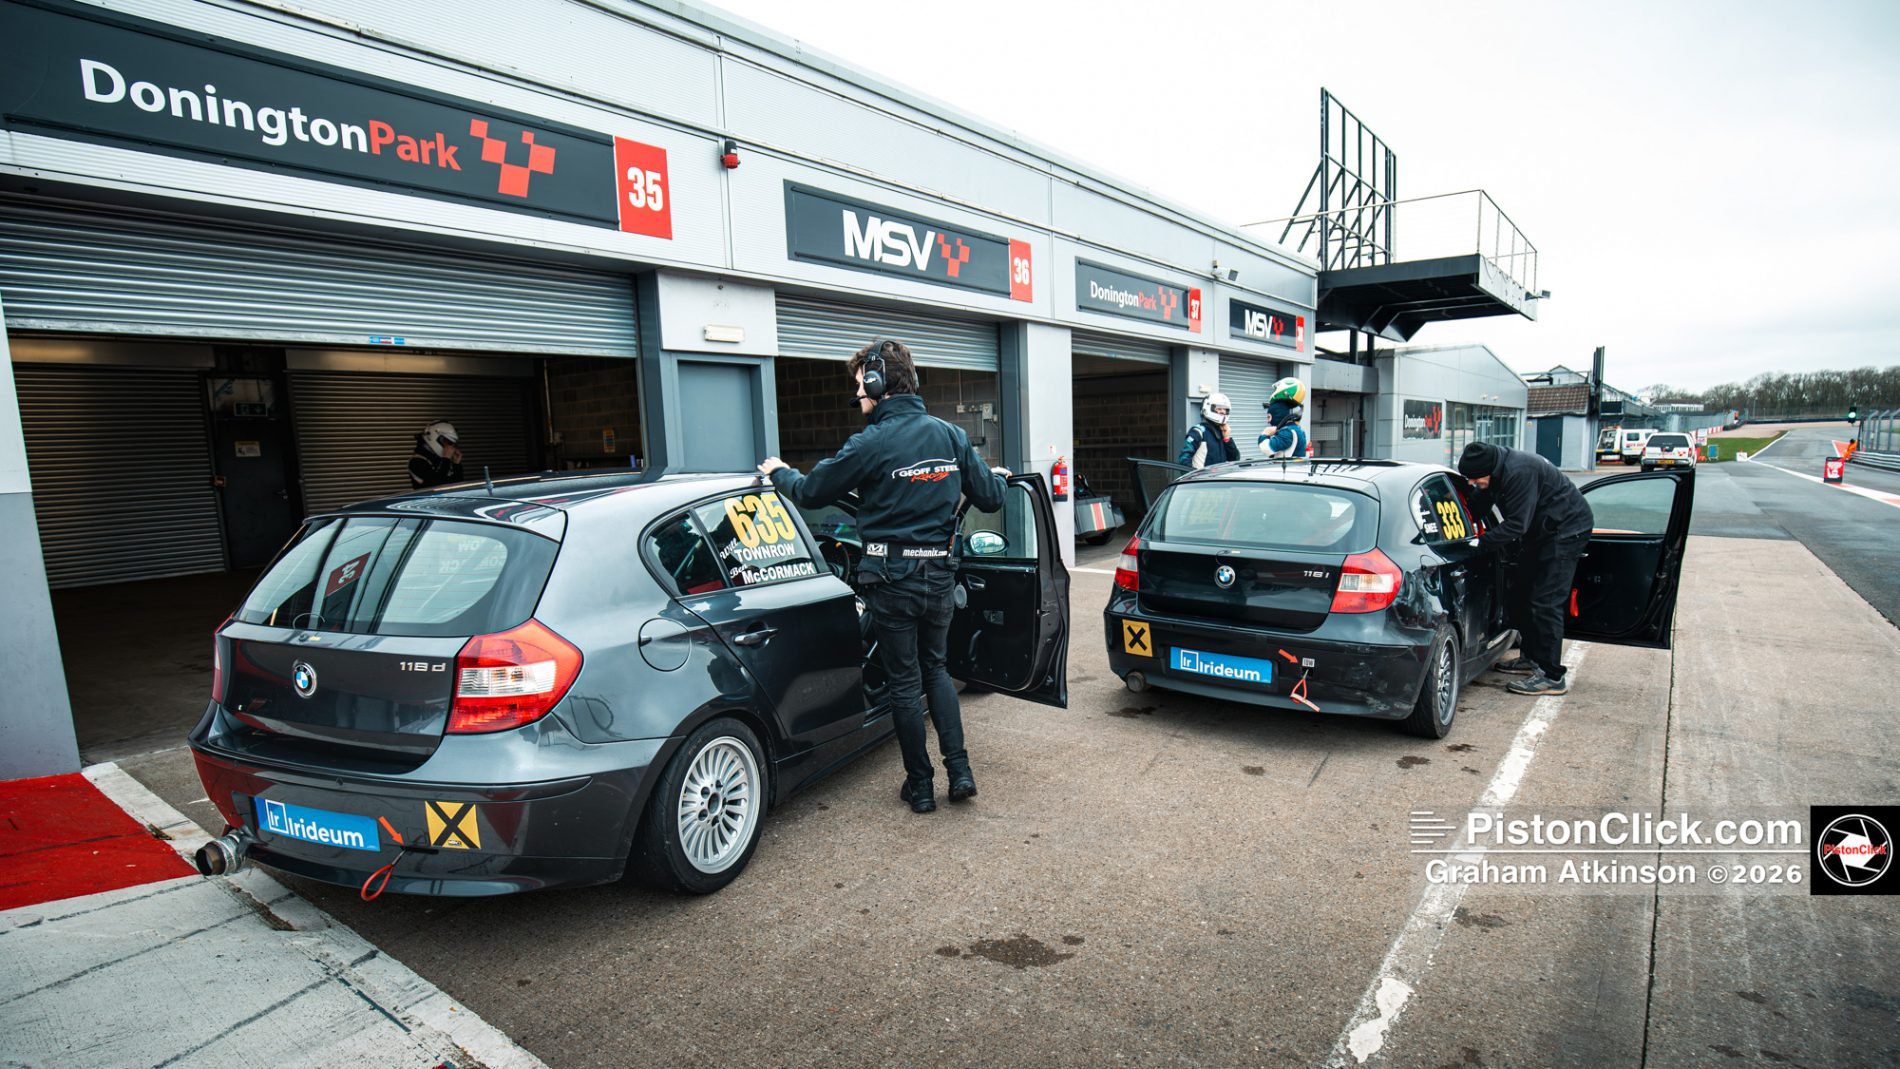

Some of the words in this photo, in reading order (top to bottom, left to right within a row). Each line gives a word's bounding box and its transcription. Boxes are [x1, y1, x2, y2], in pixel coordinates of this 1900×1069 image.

[80, 58, 462, 172] DoningtonPark
[627, 166, 664, 212] 35
[842, 209, 935, 271] MSV
[1013, 257, 1030, 285] 36
[1190, 301, 1200, 320] 37
[1244, 309, 1273, 339] MSV
[899, 467, 931, 477] GEOFF
[934, 464, 960, 473] STEEL
[723, 492, 796, 549] 635
[1436, 501, 1466, 540] 333
[734, 543, 796, 562] TOWNROW
[729, 563, 748, 579] Ben
[741, 562, 816, 585] McCORMACK
[1199, 661, 1261, 681] Irideum
[288, 817, 364, 848] Irideum
